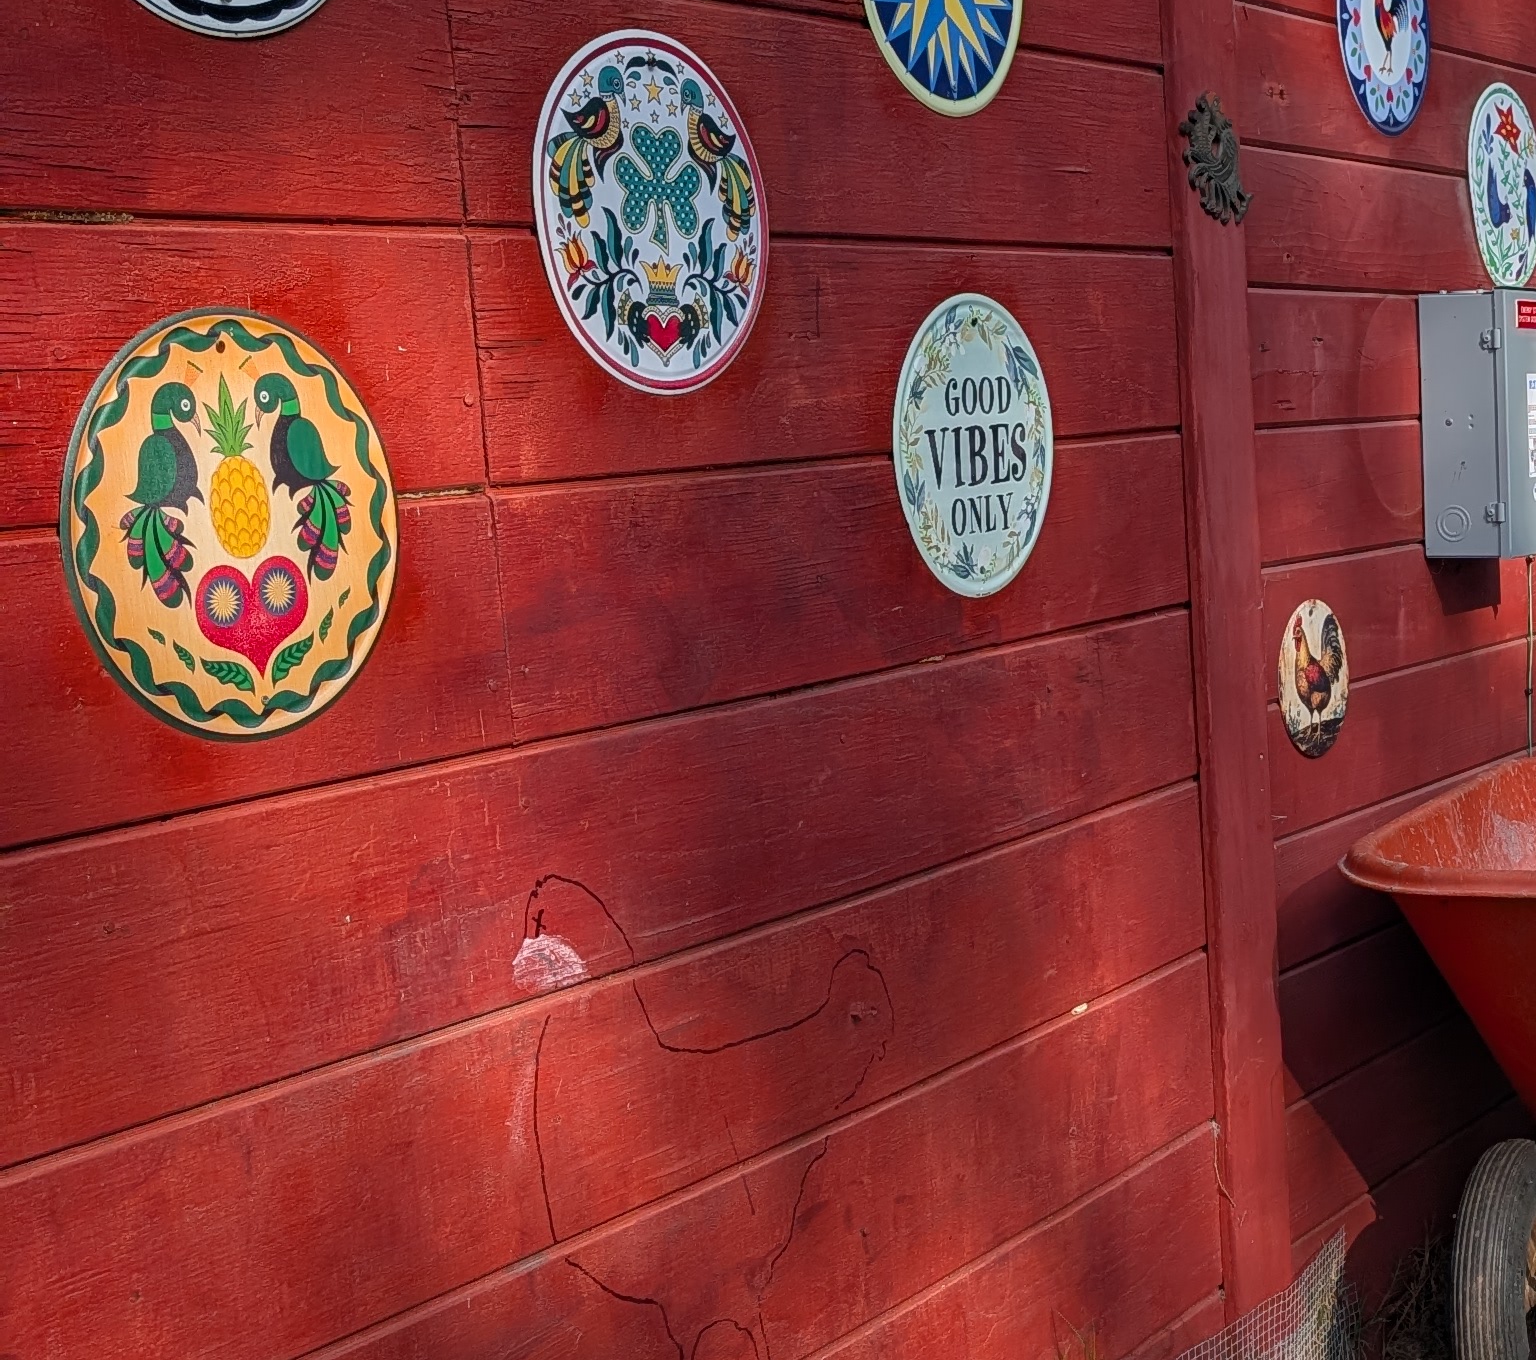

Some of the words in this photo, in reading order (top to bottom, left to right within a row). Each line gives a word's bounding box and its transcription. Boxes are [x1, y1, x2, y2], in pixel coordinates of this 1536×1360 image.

[944, 376, 1012, 417] GOOD
[924, 422, 1027, 491] VIBES
[951, 492, 1014, 537] ONLY
